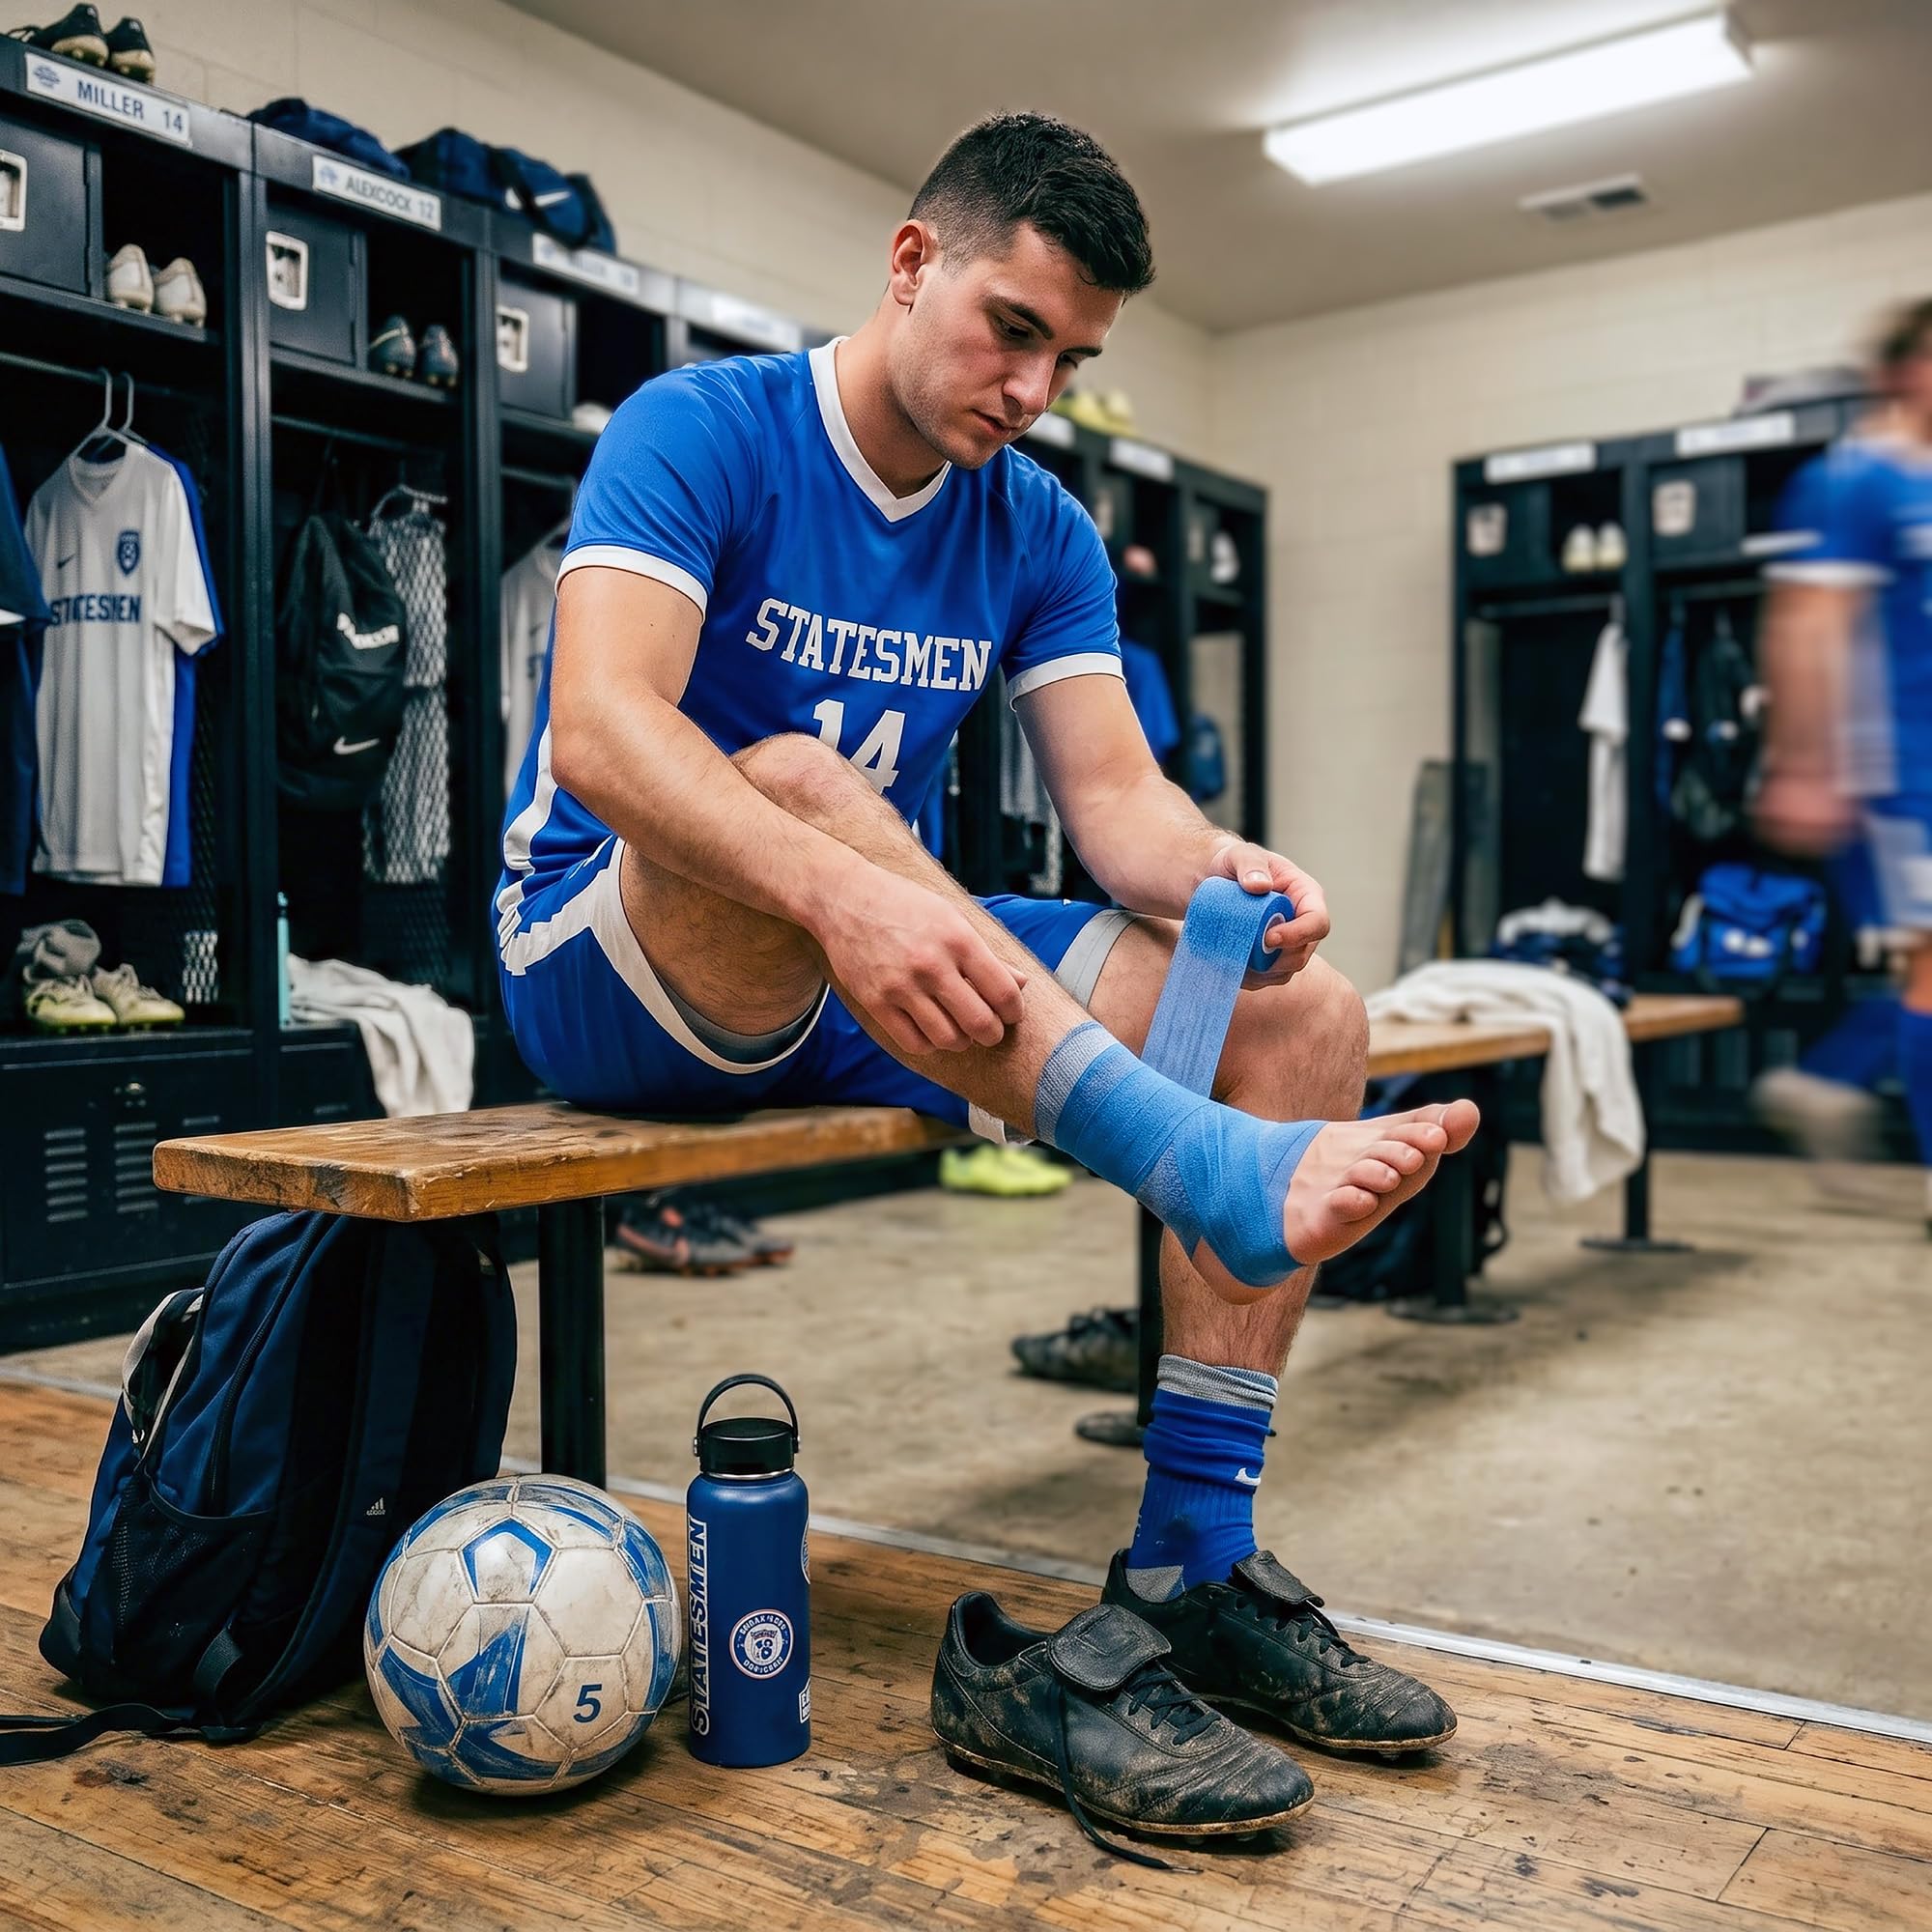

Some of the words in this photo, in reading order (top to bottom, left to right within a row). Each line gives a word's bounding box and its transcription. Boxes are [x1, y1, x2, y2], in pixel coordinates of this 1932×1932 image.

[77, 79, 144, 120] MILLER
[162, 109, 183, 132] 14
[746, 597, 992, 691] STATESMEN
[688, 1513, 710, 1736] STATESMEN
[573, 1684, 604, 1723] 5
